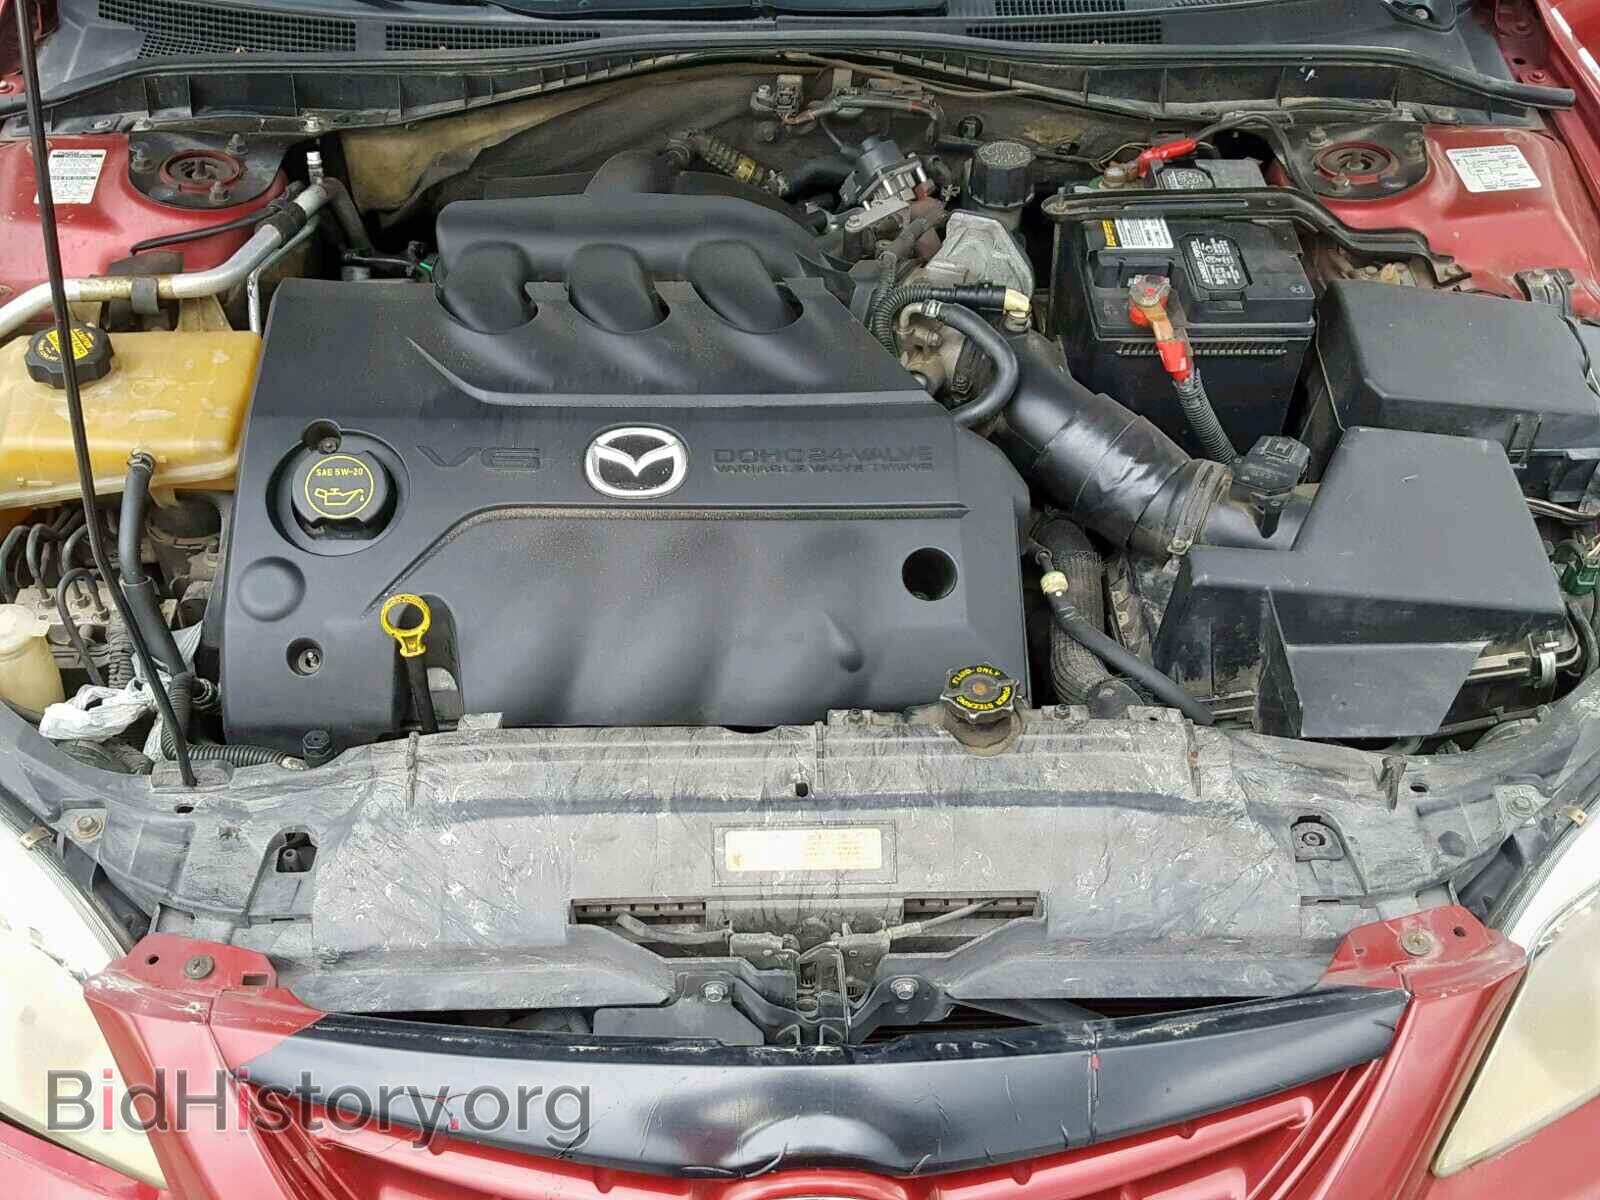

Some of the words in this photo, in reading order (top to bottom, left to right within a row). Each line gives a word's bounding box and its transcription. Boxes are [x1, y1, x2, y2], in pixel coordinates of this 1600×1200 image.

[417, 446, 541, 472] V6
[712, 448, 804, 464] DOHC
[808, 446, 933, 463] 24-VALVE
[316, 467, 333, 476] SAE
[334, 467, 364, 476] 5W-20
